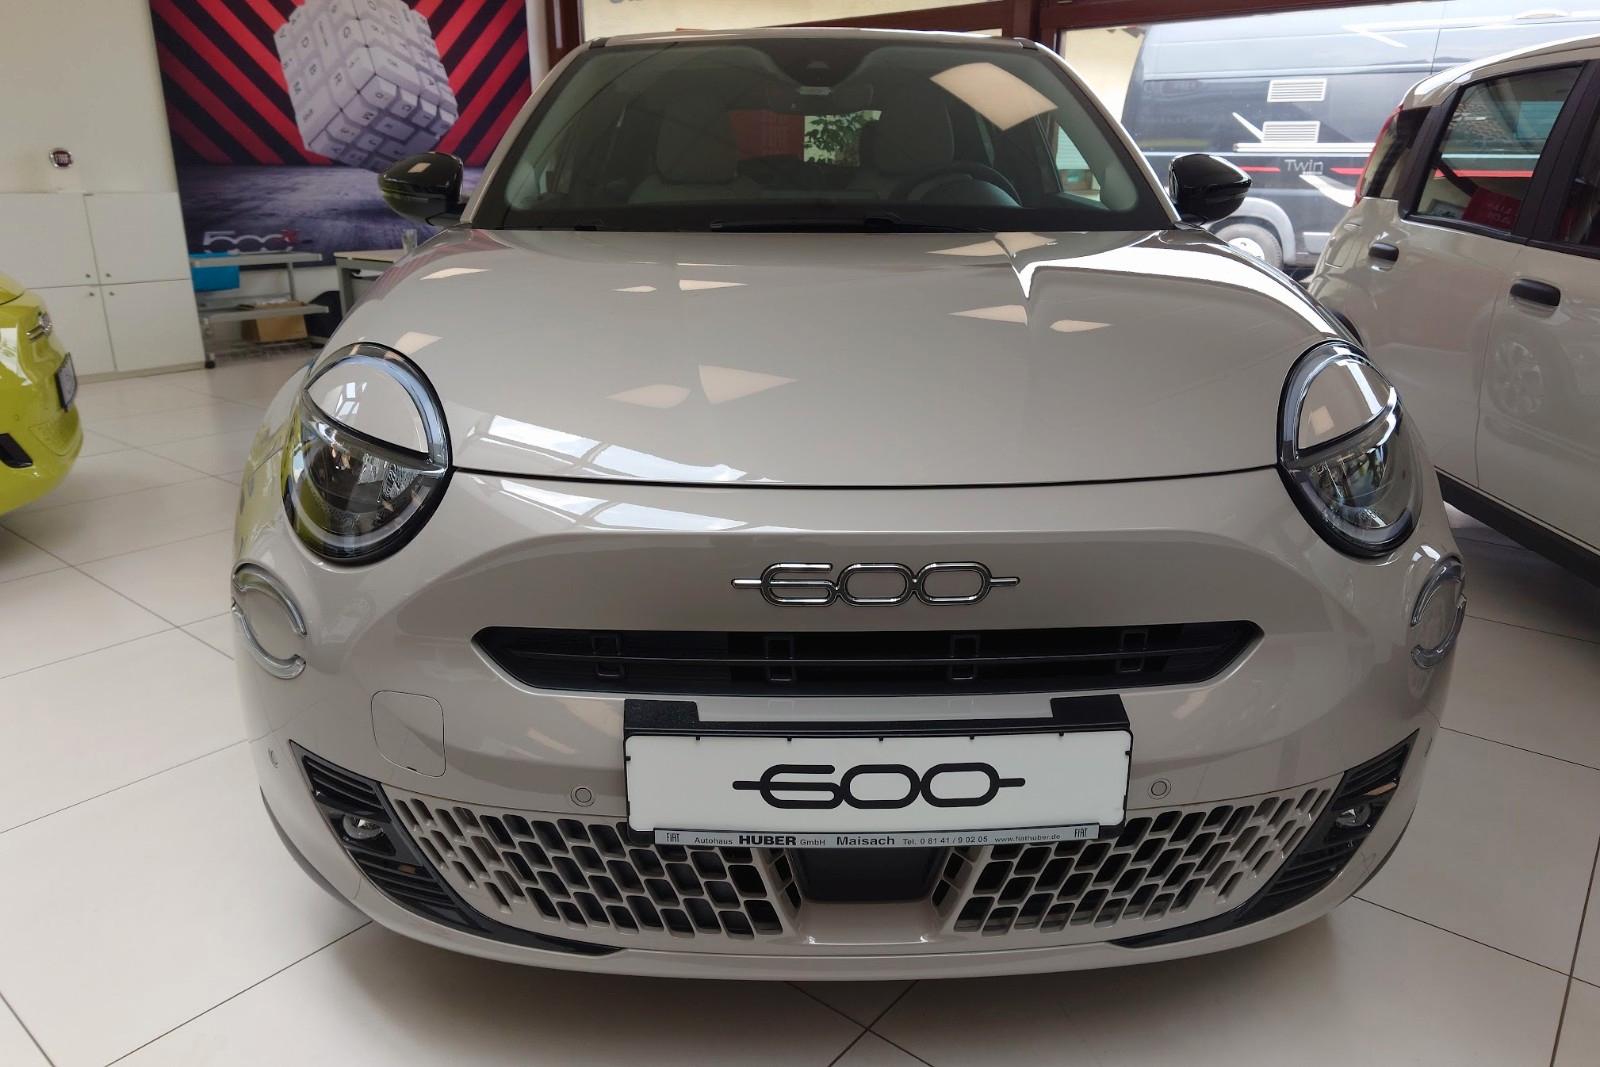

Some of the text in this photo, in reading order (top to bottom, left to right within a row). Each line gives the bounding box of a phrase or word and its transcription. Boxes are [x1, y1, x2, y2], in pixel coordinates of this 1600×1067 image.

[1283, 159, 1324, 172] Twin
[731, 561, 1020, 607] 600
[732, 762, 1026, 809] 600
[694, 836, 733, 845] Autohaus
[738, 835, 797, 846] HUBER
[799, 838, 826, 846] GmbH
[836, 835, 895, 846] Maisach
[902, 838, 917, 846] Tel.
